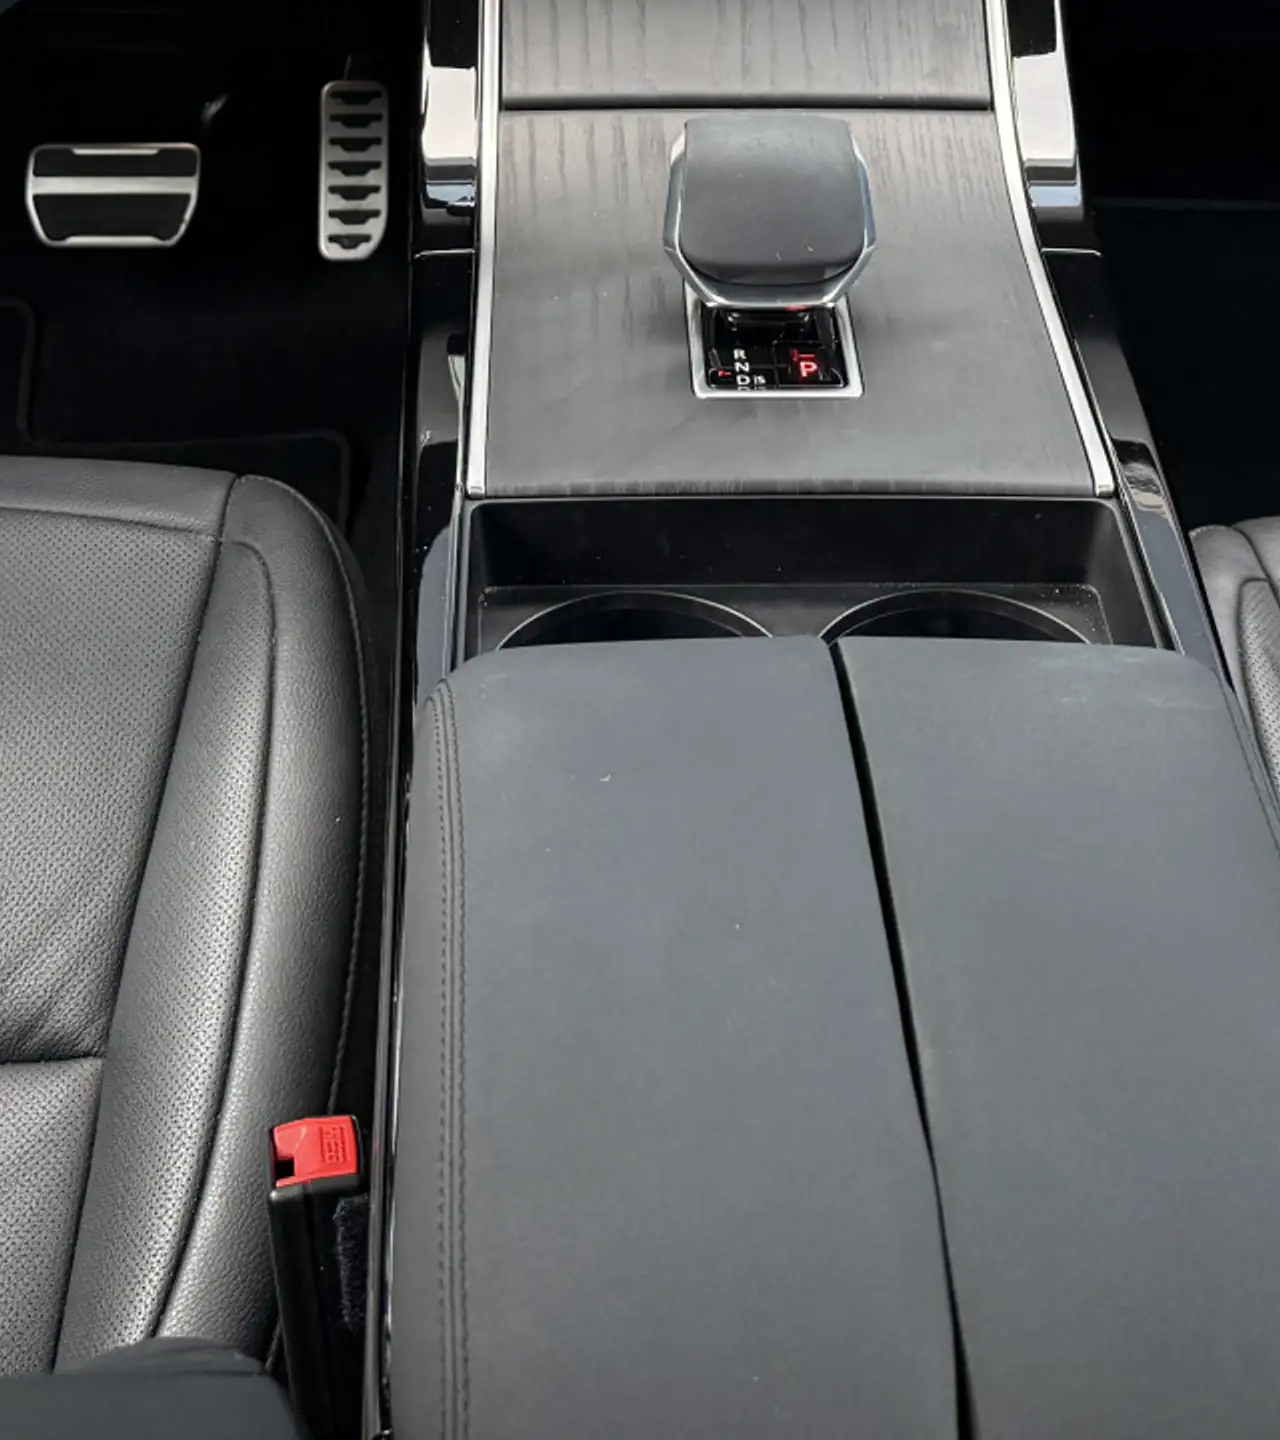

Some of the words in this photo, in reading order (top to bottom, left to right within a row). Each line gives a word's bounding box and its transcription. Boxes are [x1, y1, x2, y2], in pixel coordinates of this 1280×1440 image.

[734, 348, 747, 360] R
[734, 362, 750, 373] N
[800, 361, 818, 378] P
[736, 374, 751, 386] D
